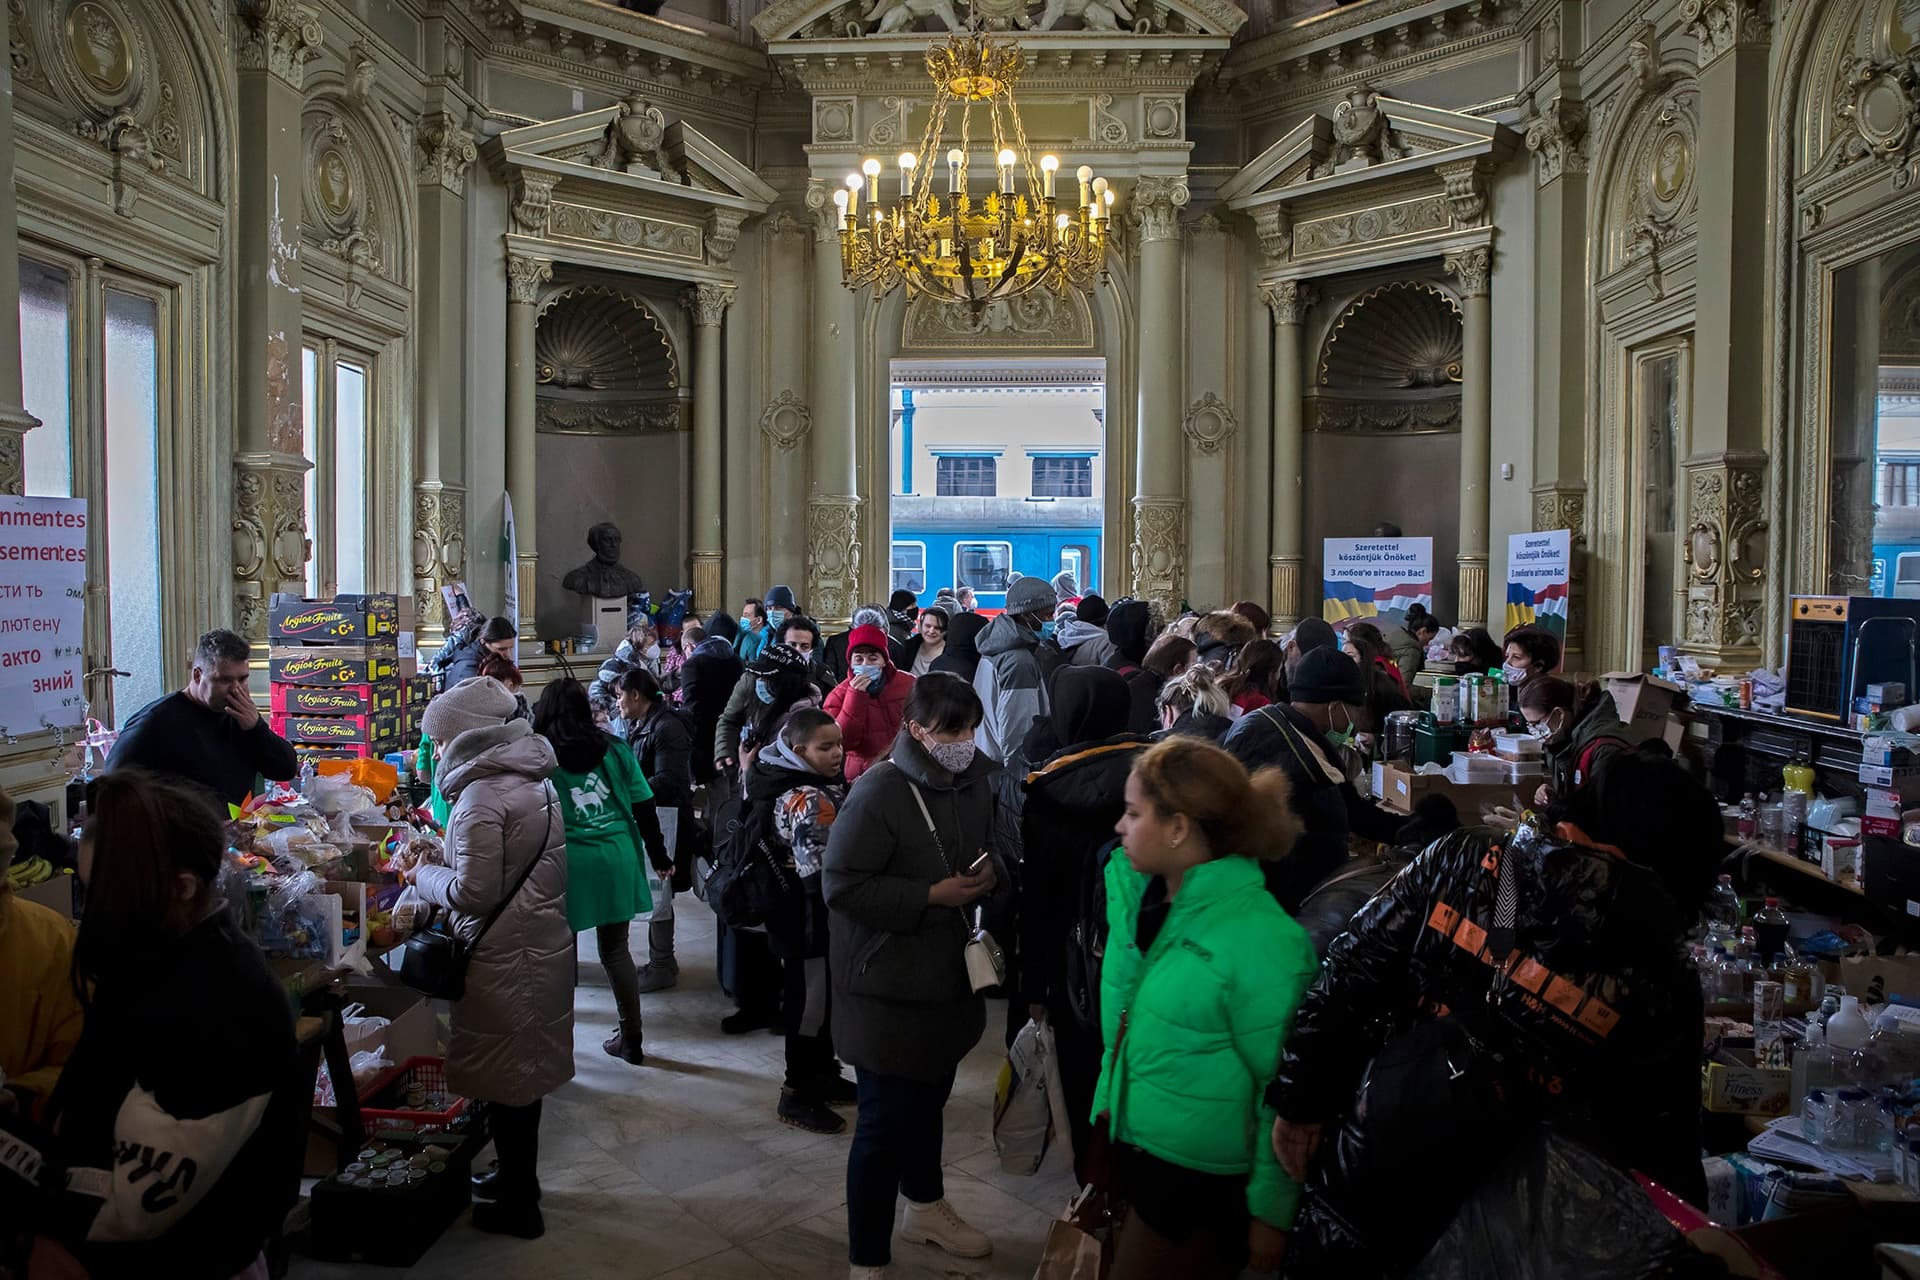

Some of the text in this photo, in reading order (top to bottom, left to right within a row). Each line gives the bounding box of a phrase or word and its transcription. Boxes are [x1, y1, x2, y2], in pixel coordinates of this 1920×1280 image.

[1355, 543, 1399, 551] Szeretettel
[1383, 552, 1417, 561] Önöket!
[33, 670, 74, 693] зний
[297, 693, 358, 707] Argios Fruits
[296, 721, 356, 736] Argios Fruits
